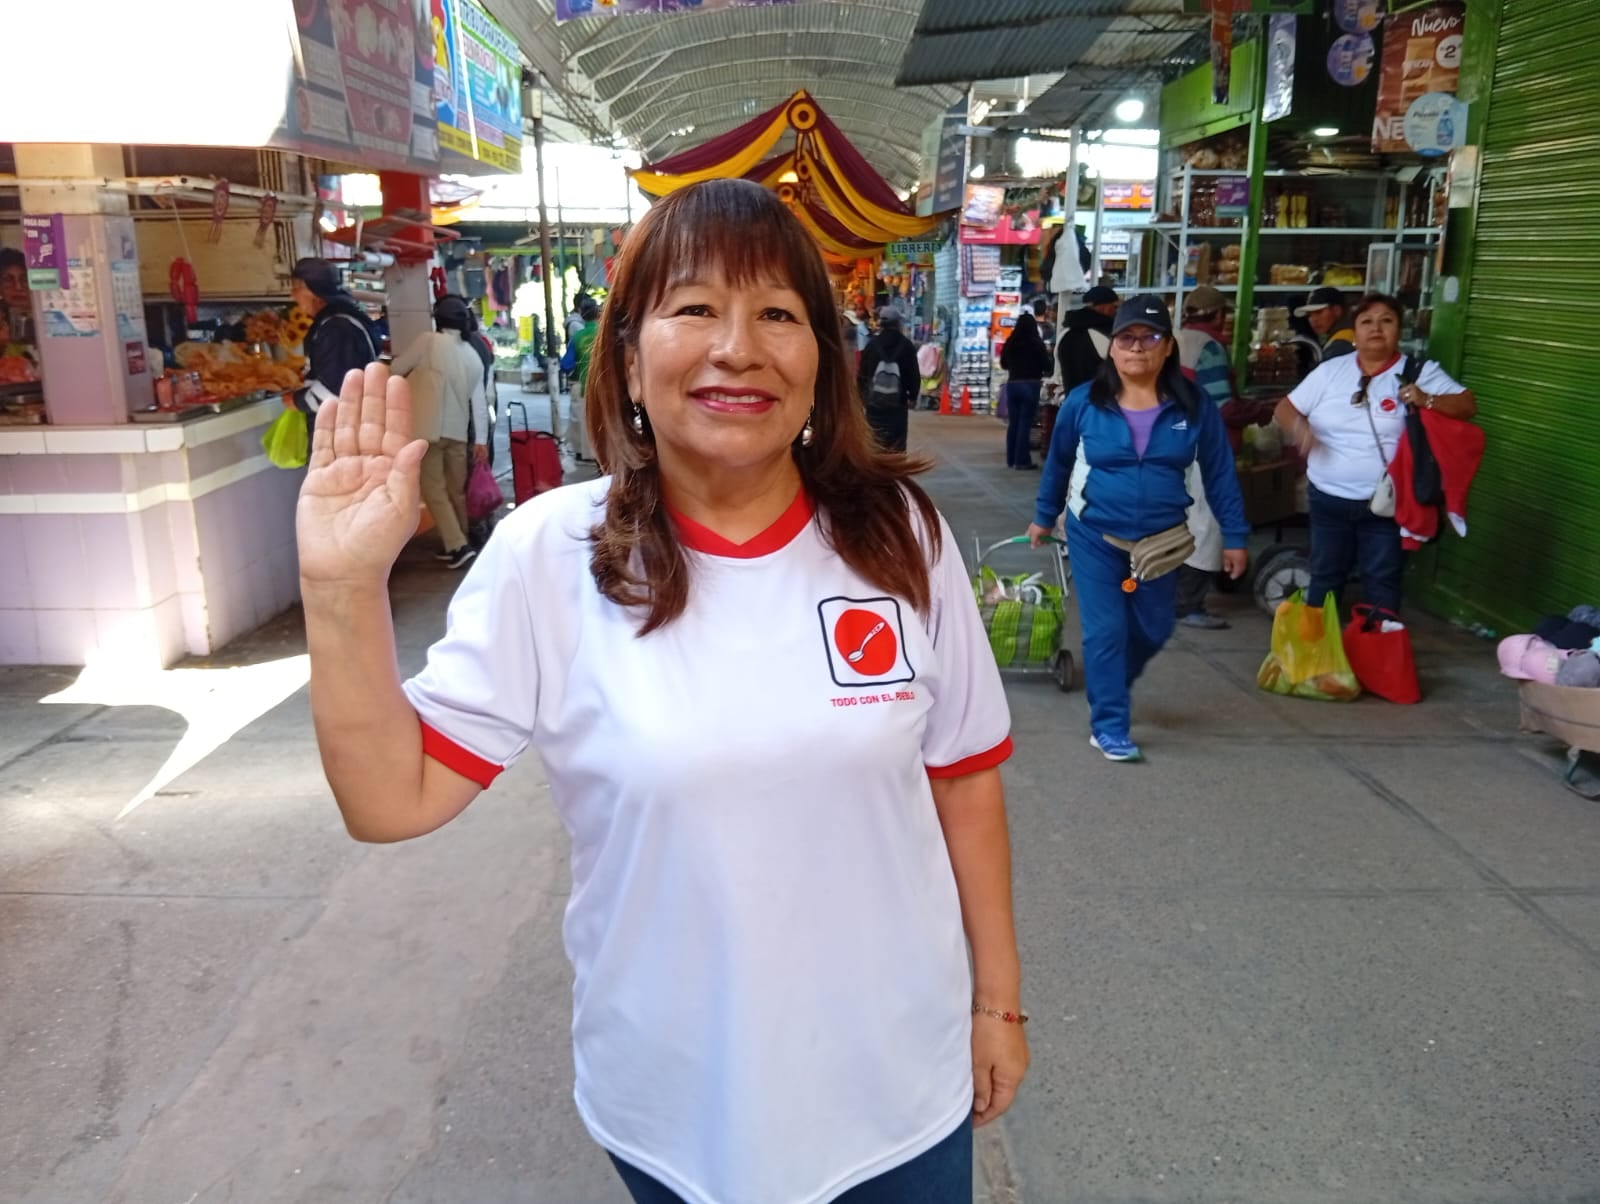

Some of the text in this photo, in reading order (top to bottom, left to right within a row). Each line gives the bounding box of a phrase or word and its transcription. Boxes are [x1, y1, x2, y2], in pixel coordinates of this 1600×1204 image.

[1411, 14, 1460, 37] Nuevo
[1443, 45, 1457, 59] 2
[831, 697, 857, 707] TODO
[860, 695, 879, 705] CON
[881, 693, 895, 702] EL
